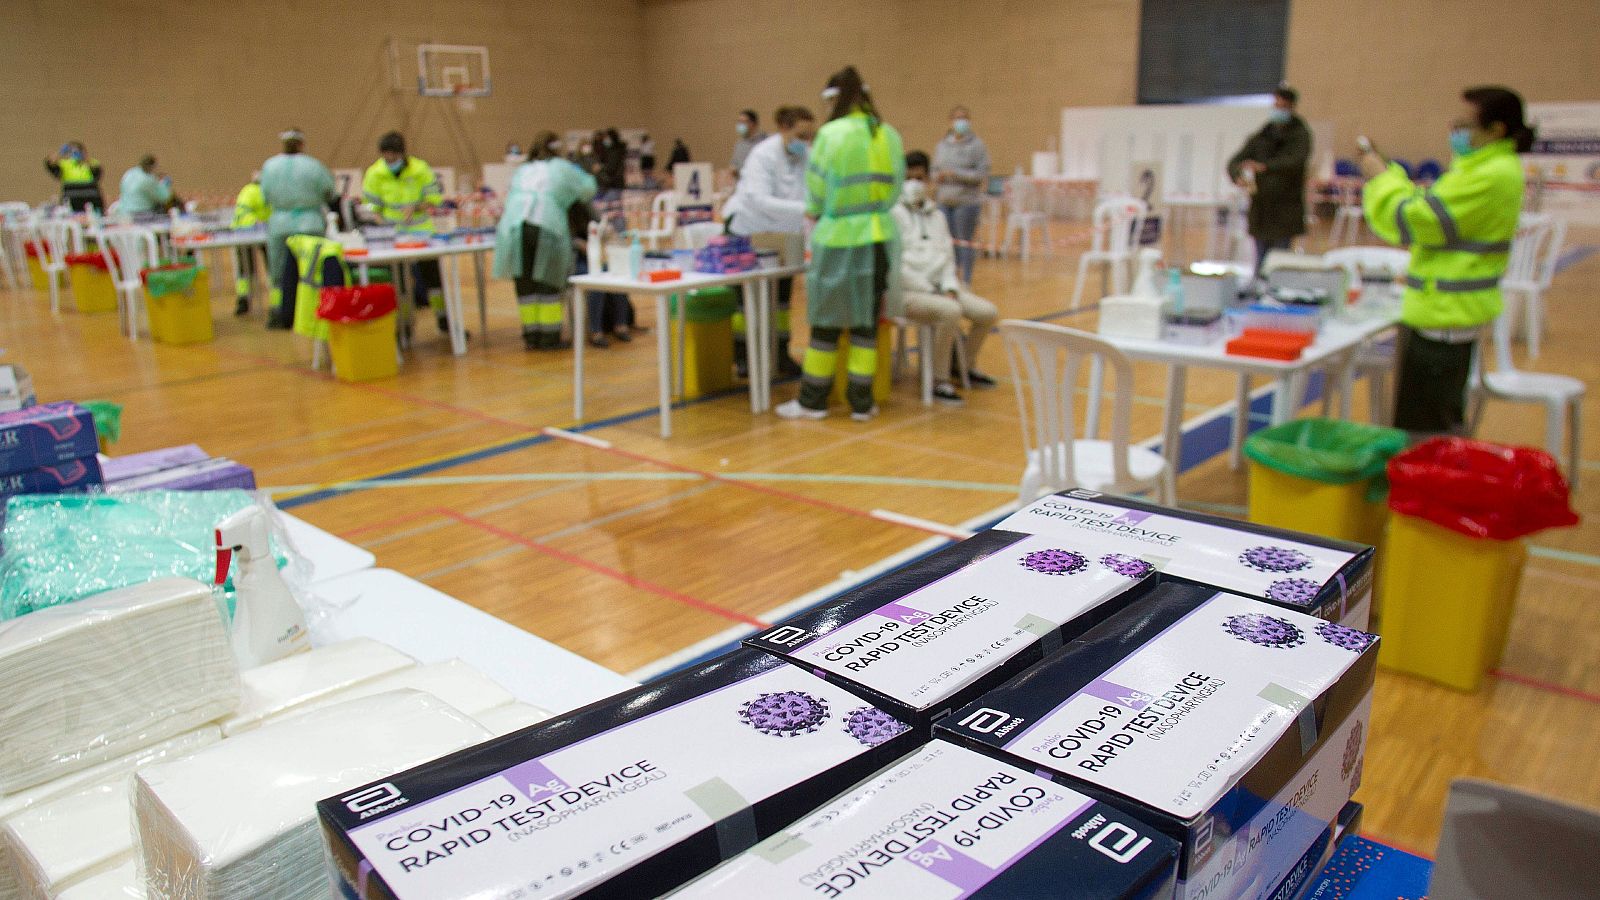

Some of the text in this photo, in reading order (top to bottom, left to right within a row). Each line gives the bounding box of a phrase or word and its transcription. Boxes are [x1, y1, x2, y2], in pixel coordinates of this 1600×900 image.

[687, 170, 702, 199] 4
[1030, 507, 1183, 543] RAPID TEST DEVICE
[1043, 501, 1115, 519] COVID-19
[844, 595, 988, 672] RAPID TEST DEVICE
[900, 611, 930, 624] Ag
[911, 599, 999, 648] (NASOPHARYNGEAL)
[825, 621, 900, 662] COVID-19
[1116, 691, 1152, 707] Ag
[1146, 678, 1226, 741] (NASOPHARYNGEAL)
[994, 717, 1025, 739] Abbott
[1048, 705, 1122, 759] COVID-19
[1078, 671, 1211, 773] RAPID TEST DEVICE
[1032, 733, 1063, 753] Panbio
[360, 797, 410, 819] Abbott
[507, 769, 667, 842] (NASOPHARYNGEAL)
[528, 779, 567, 797] Ag
[951, 772, 1017, 811] RAPID
[385, 793, 516, 852] COVID-19
[399, 759, 657, 873] RAPID TEST DEVICE
[903, 810, 960, 844] TEST
[954, 786, 1046, 848] COVID-19
[1071, 813, 1107, 840] Abbott
[1249, 818, 1275, 853] RAPID
[1276, 796, 1294, 826] TEST
[1293, 769, 1319, 807] DEVICE
[799, 802, 935, 887] (NASOPHARYNGEAL)
[908, 844, 953, 868] Ag
[815, 839, 910, 899] DEVICE
